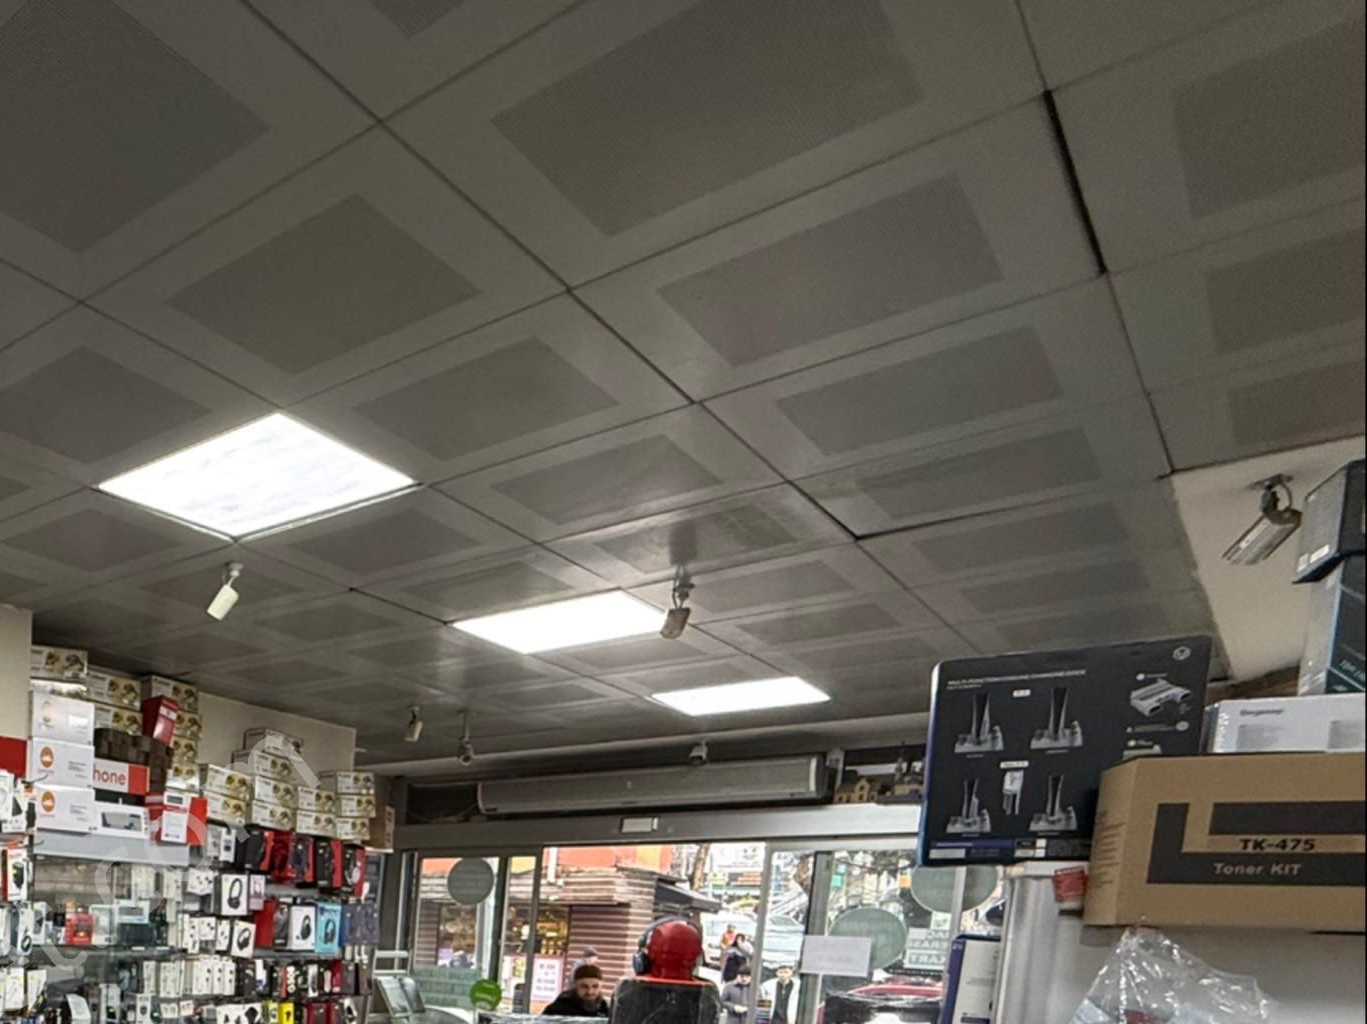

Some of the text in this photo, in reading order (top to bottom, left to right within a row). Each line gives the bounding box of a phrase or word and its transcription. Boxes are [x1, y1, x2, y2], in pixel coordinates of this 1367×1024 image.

[93, 764, 127, 786] hone
[1238, 838, 1316, 851] TK-475
[1212, 862, 1302, 876] Toner KIT
